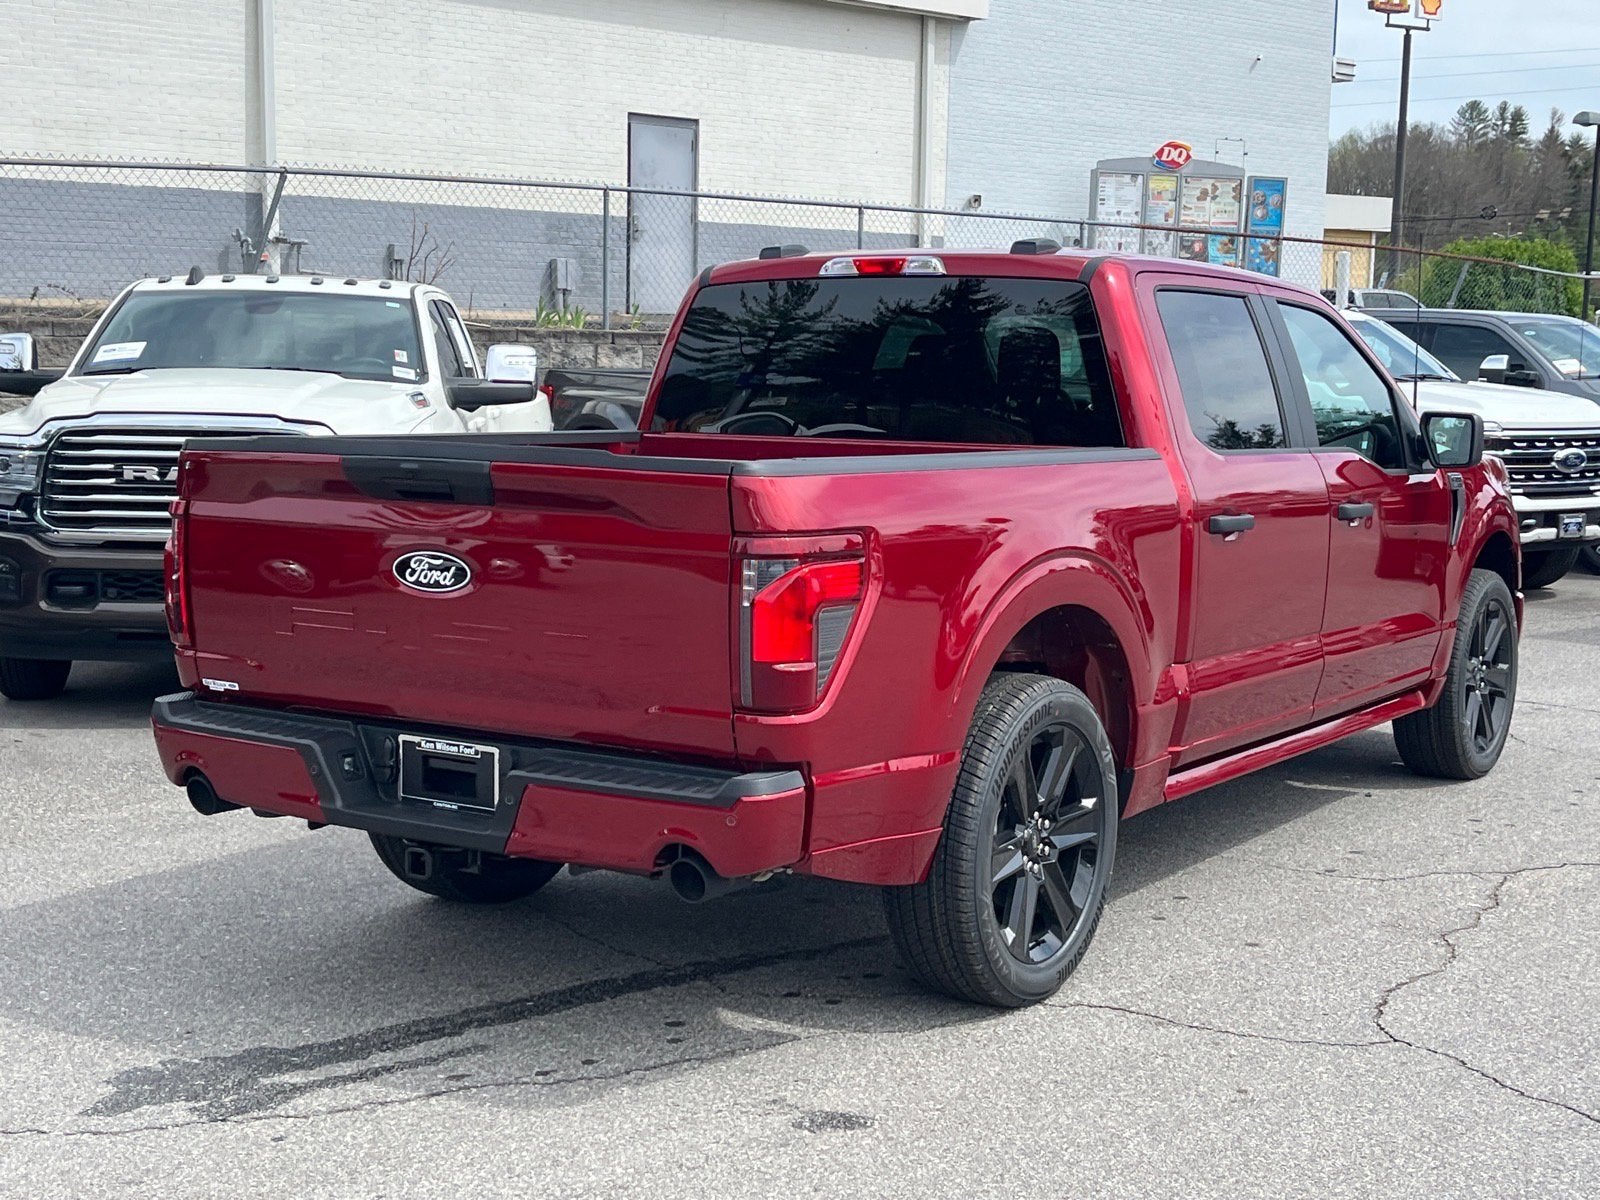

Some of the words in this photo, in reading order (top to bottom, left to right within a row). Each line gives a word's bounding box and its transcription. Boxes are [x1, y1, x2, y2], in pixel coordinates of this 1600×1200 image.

[1160, 146, 1188, 165] DQ
[405, 556, 456, 586] Ford
[421, 740, 435, 749] Ken
[435, 742, 459, 753] Wilson
[460, 745, 475, 755] Ford
[991, 701, 1054, 800] BRIDGESTONE
